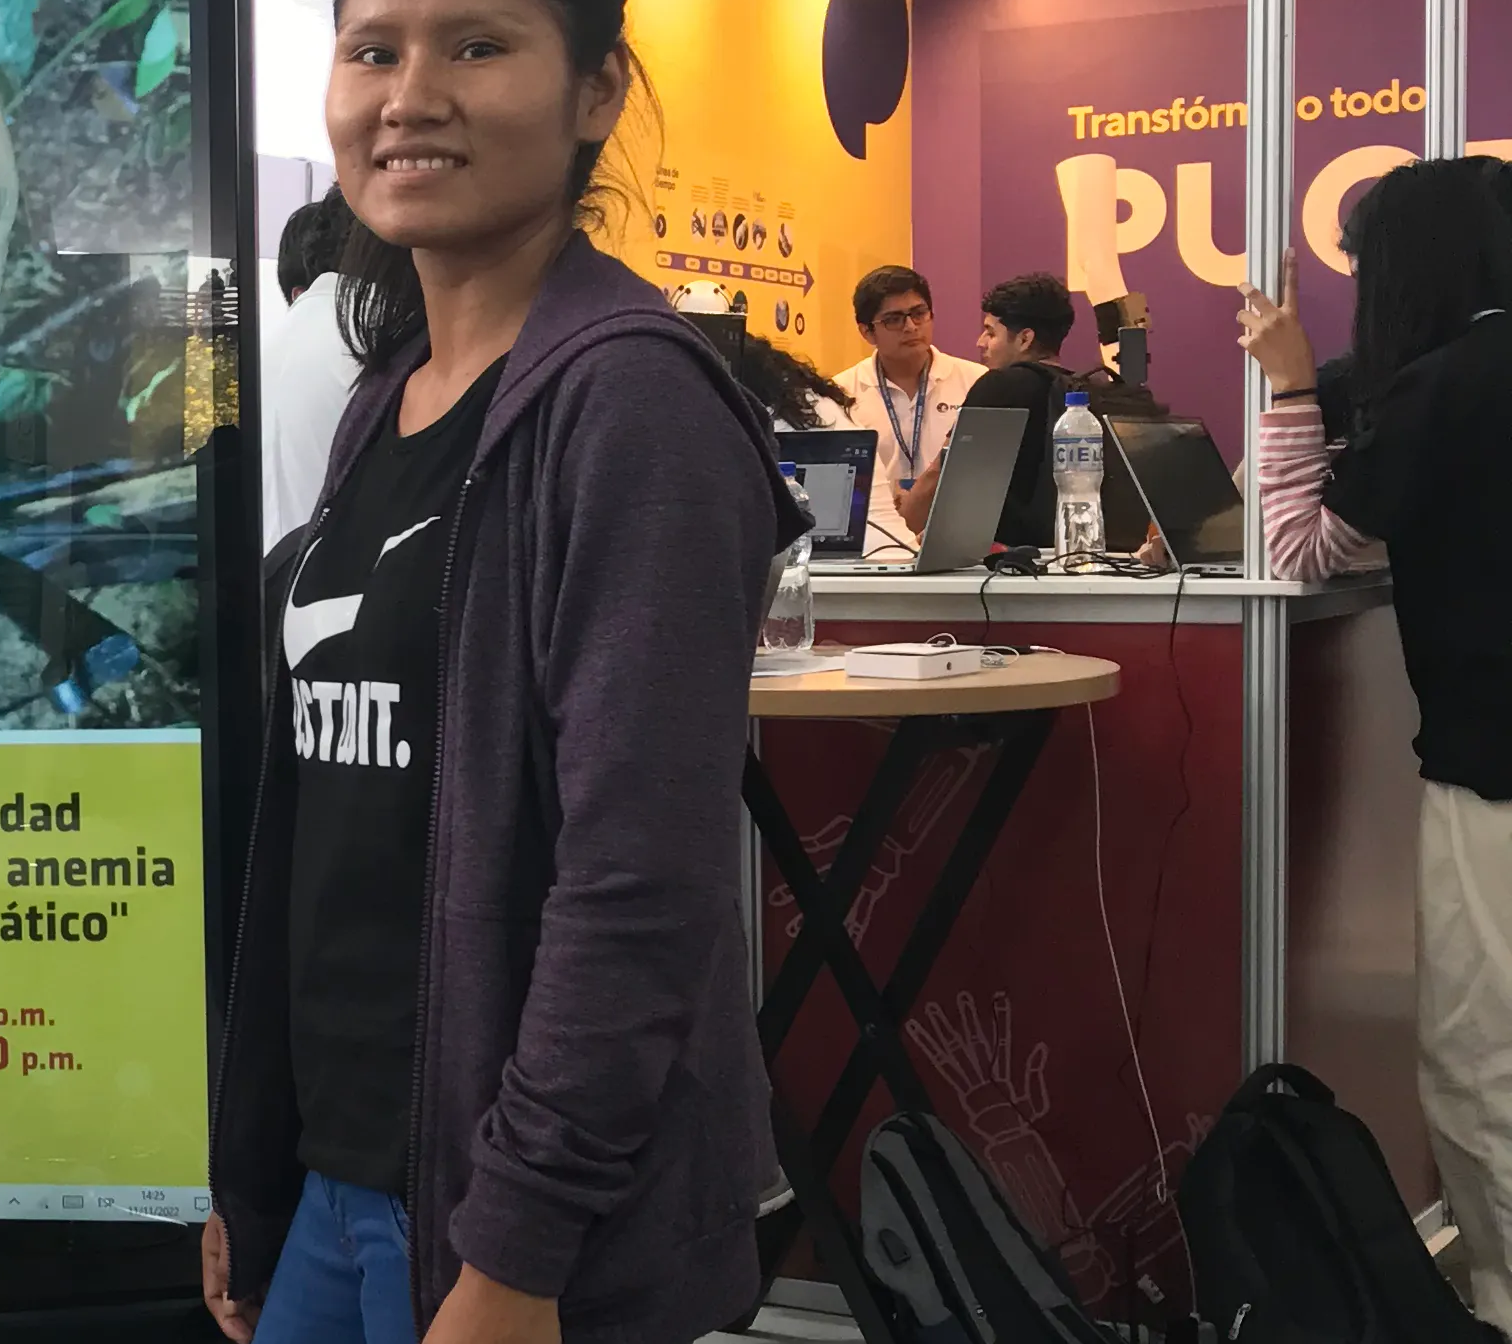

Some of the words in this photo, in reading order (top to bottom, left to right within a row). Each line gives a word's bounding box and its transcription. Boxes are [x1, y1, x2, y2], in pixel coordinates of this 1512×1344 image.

[1330, 78, 1427, 119] todo
[1056, 140, 1512, 296] PUC
[5, 846, 176, 888] anemia
[21, 1044, 83, 1077] p.m.
